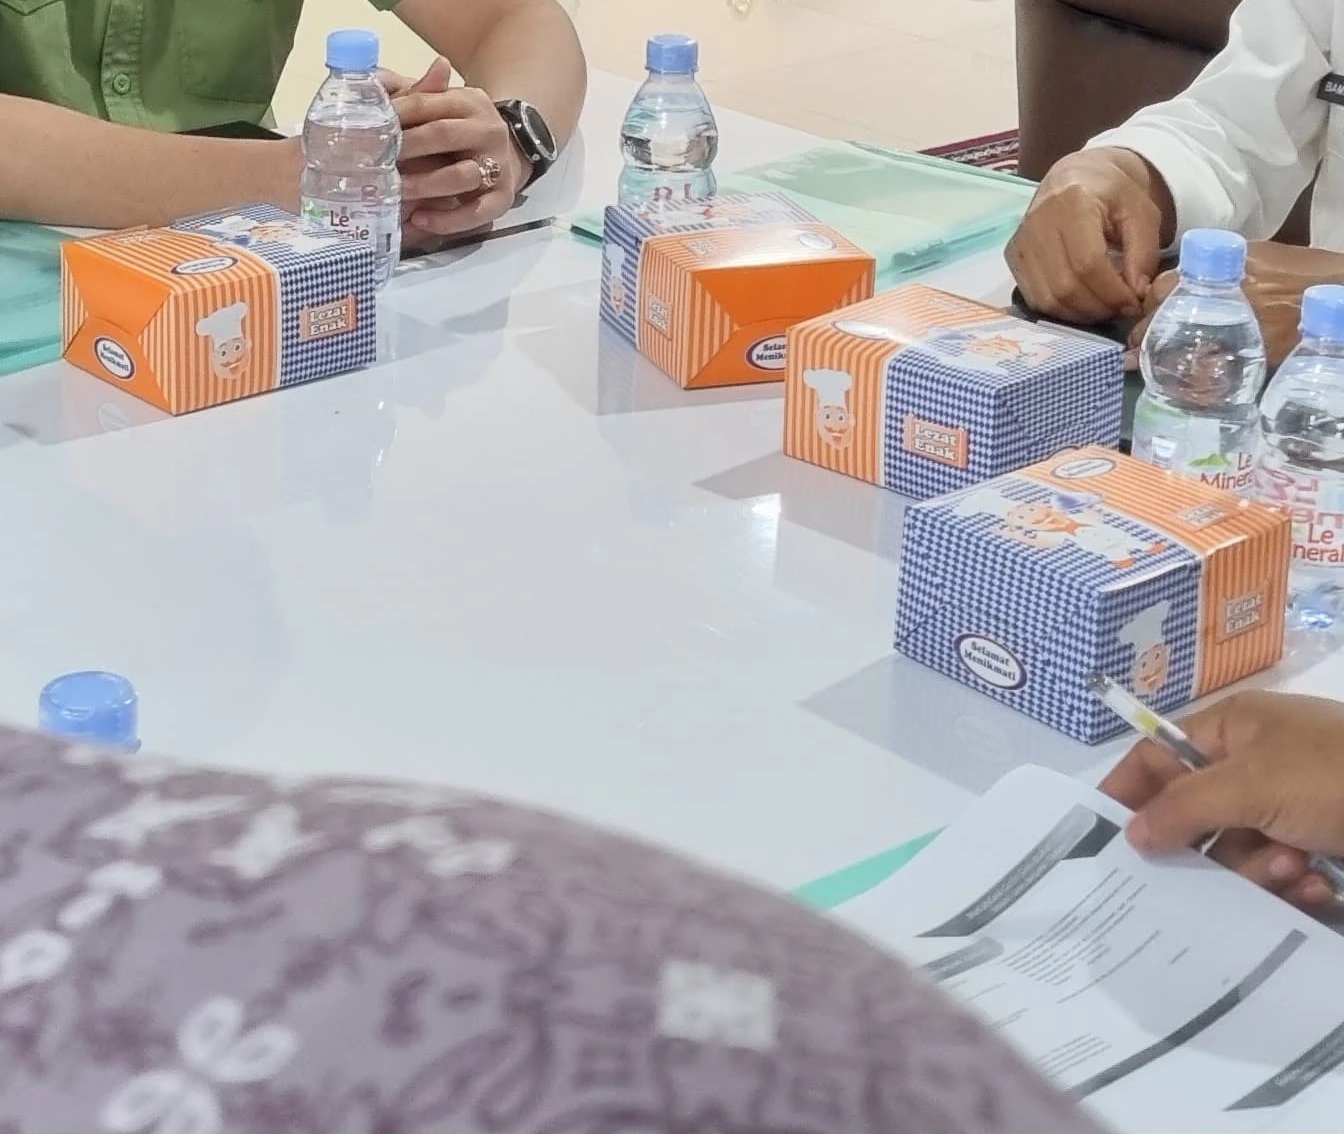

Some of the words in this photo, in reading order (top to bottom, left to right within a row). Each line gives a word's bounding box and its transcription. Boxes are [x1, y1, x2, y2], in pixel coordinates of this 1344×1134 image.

[309, 305, 348, 323] Lezat
[310, 318, 347, 336] Enak
[914, 422, 957, 446] Lezat
[914, 437, 956, 460] Enak
[1308, 523, 1335, 544] Le
[971, 642, 1010, 667] Selamat
